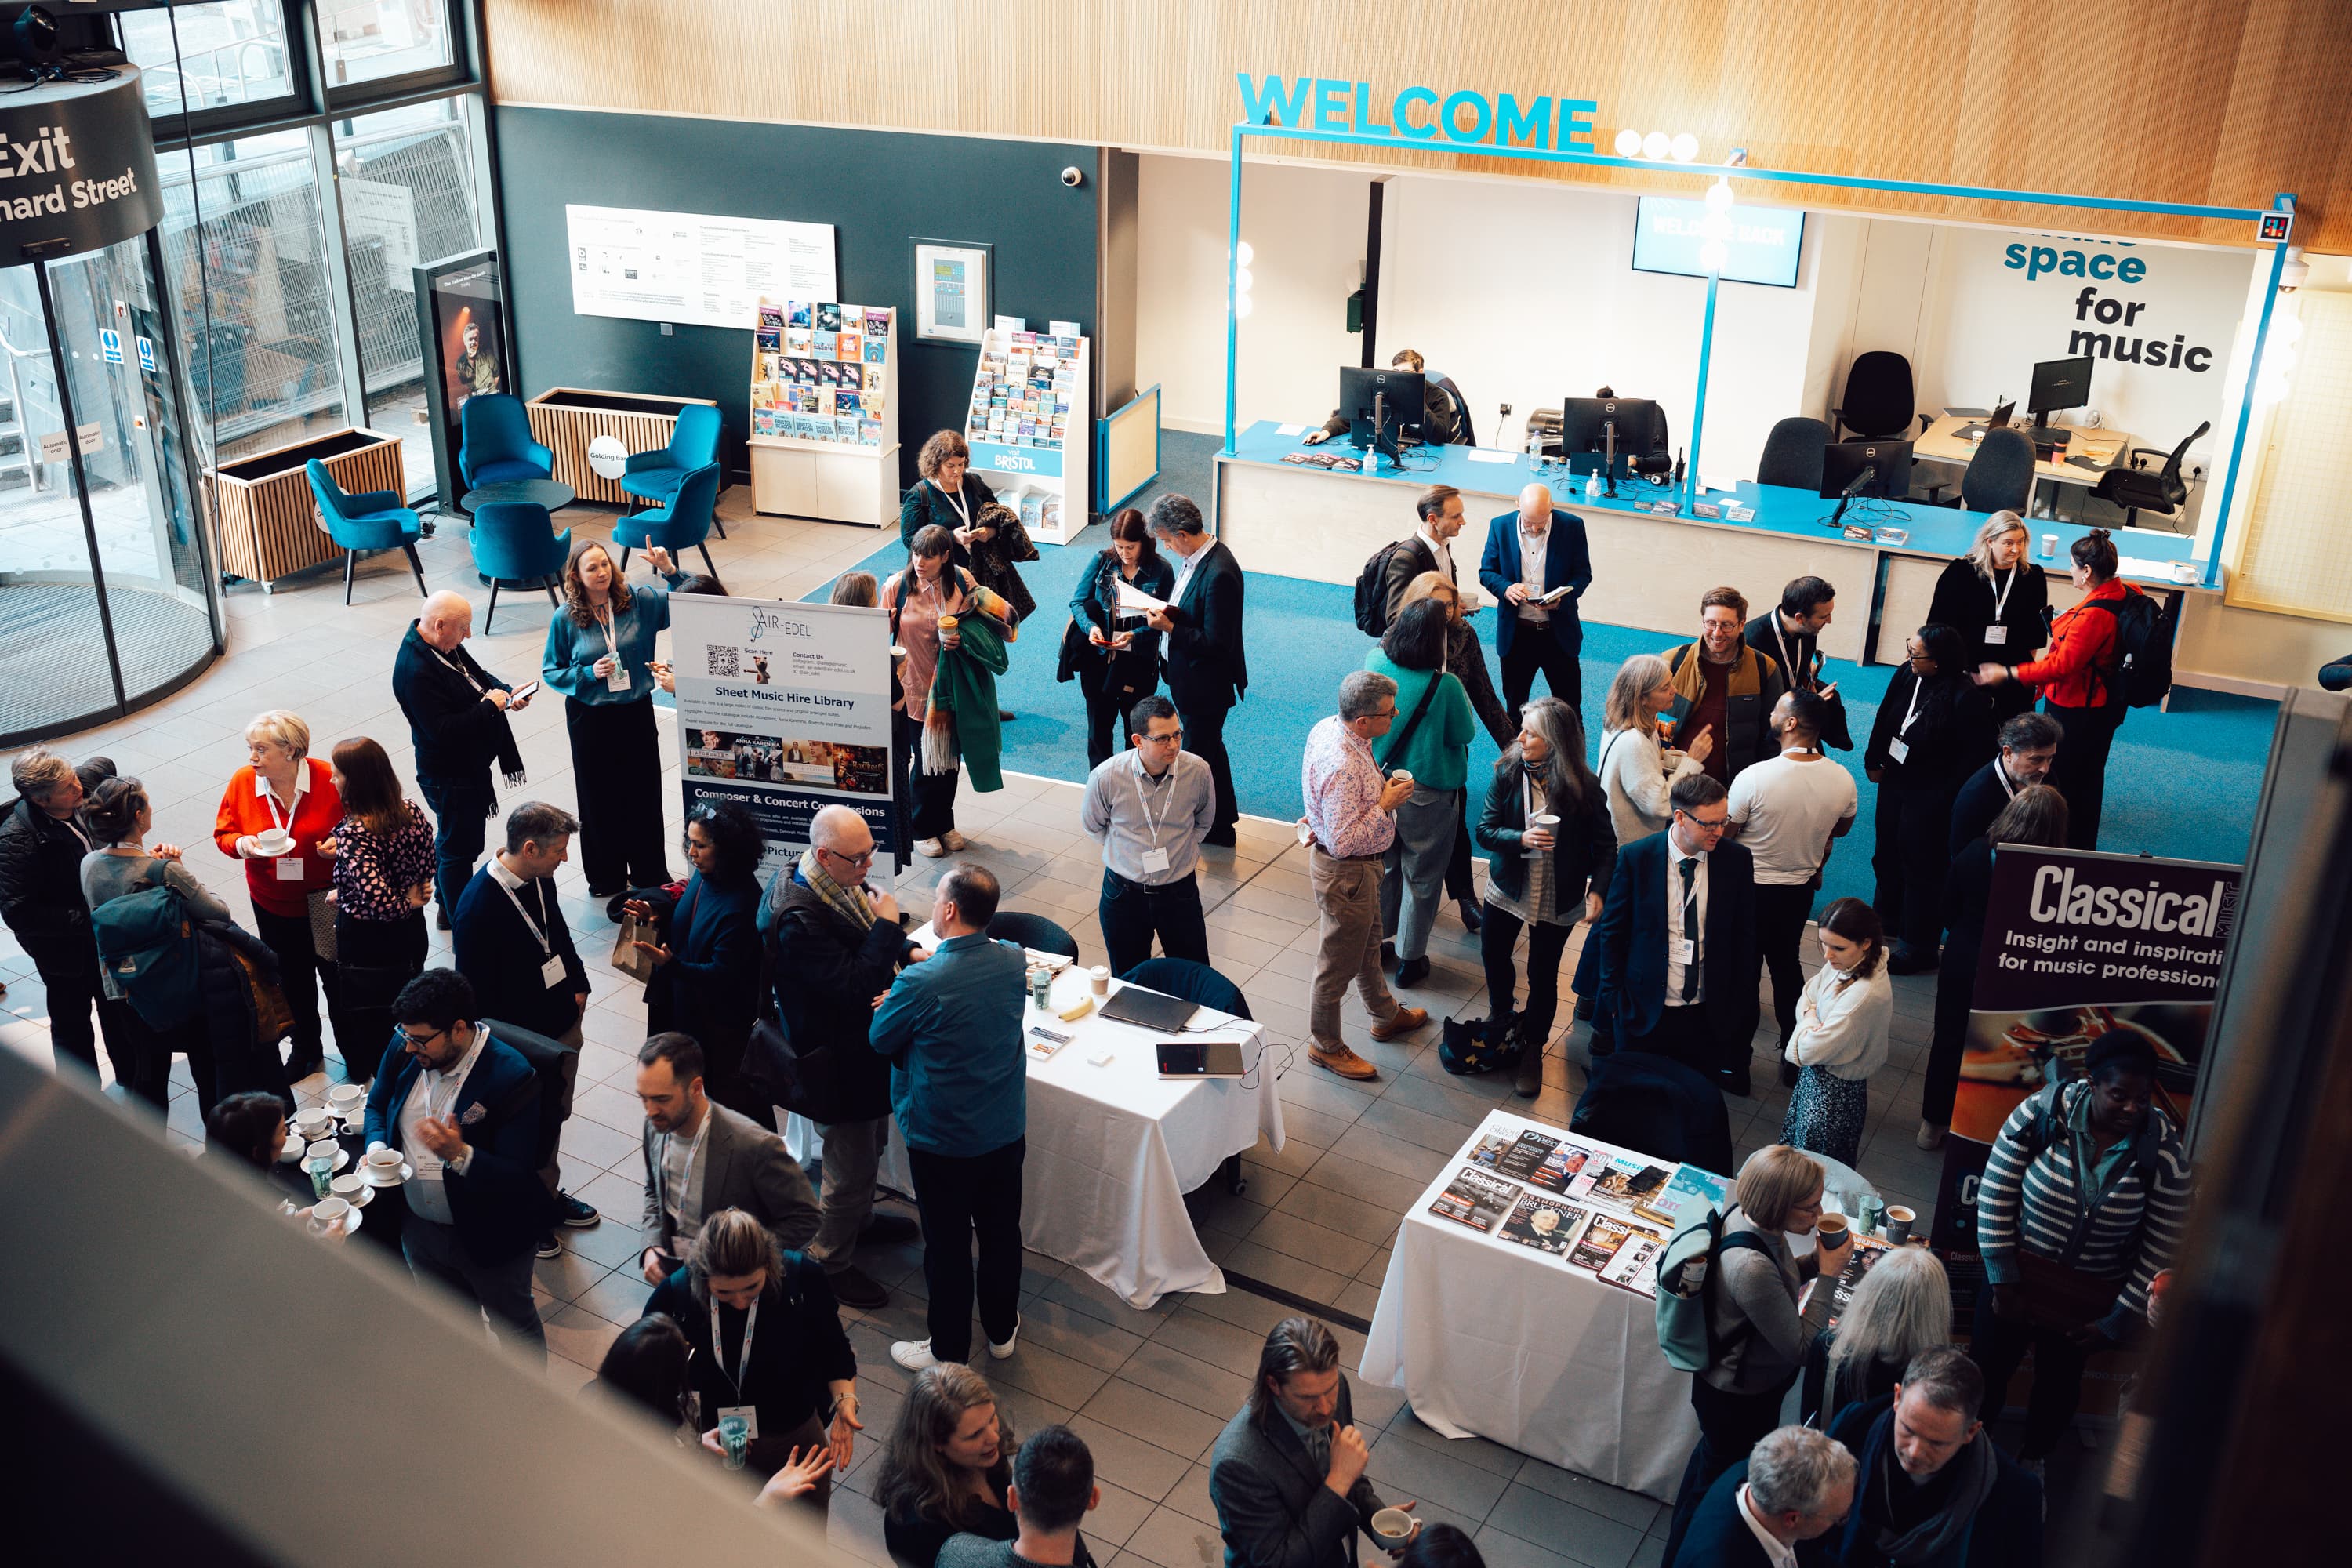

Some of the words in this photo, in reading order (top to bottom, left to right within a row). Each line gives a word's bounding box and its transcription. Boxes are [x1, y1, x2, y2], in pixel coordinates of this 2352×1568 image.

[1236, 73, 1598, 153] WELCOME
[0, 126, 75, 178] Exit
[71, 166, 137, 209] Street
[1653, 215, 1733, 240] WELCE
[2004, 243, 2146, 284] space
[2075, 286, 2146, 327] for
[2067, 329, 2213, 372] music
[43, 439, 67, 449] Automatic
[79, 430, 100, 440] Automatic
[50, 446, 62, 455] door
[590, 452, 615, 461] Golding
[994, 454, 1036, 470] BRISTOL
[715, 687, 748, 698] Sheet
[751, 689, 784, 702] Music
[787, 693, 811, 704] Hire
[814, 695, 855, 710] Library
[753, 794, 762, 804] &
[764, 796, 808, 809] Concert
[2029, 865, 2224, 938] Classical
[2005, 930, 2078, 953] Insight
[2084, 938, 2126, 955] and
[2132, 941, 2226, 966] inspirati
[1998, 953, 2027, 971] for
[2034, 958, 2096, 975] music
[1461, 1168, 1514, 1194] Classical
[1520, 1198, 1581, 1220] BRUCKNER
[1523, 1193, 1587, 1214] GRAMOPHONE
[1594, 1215, 1631, 1236] Classi
